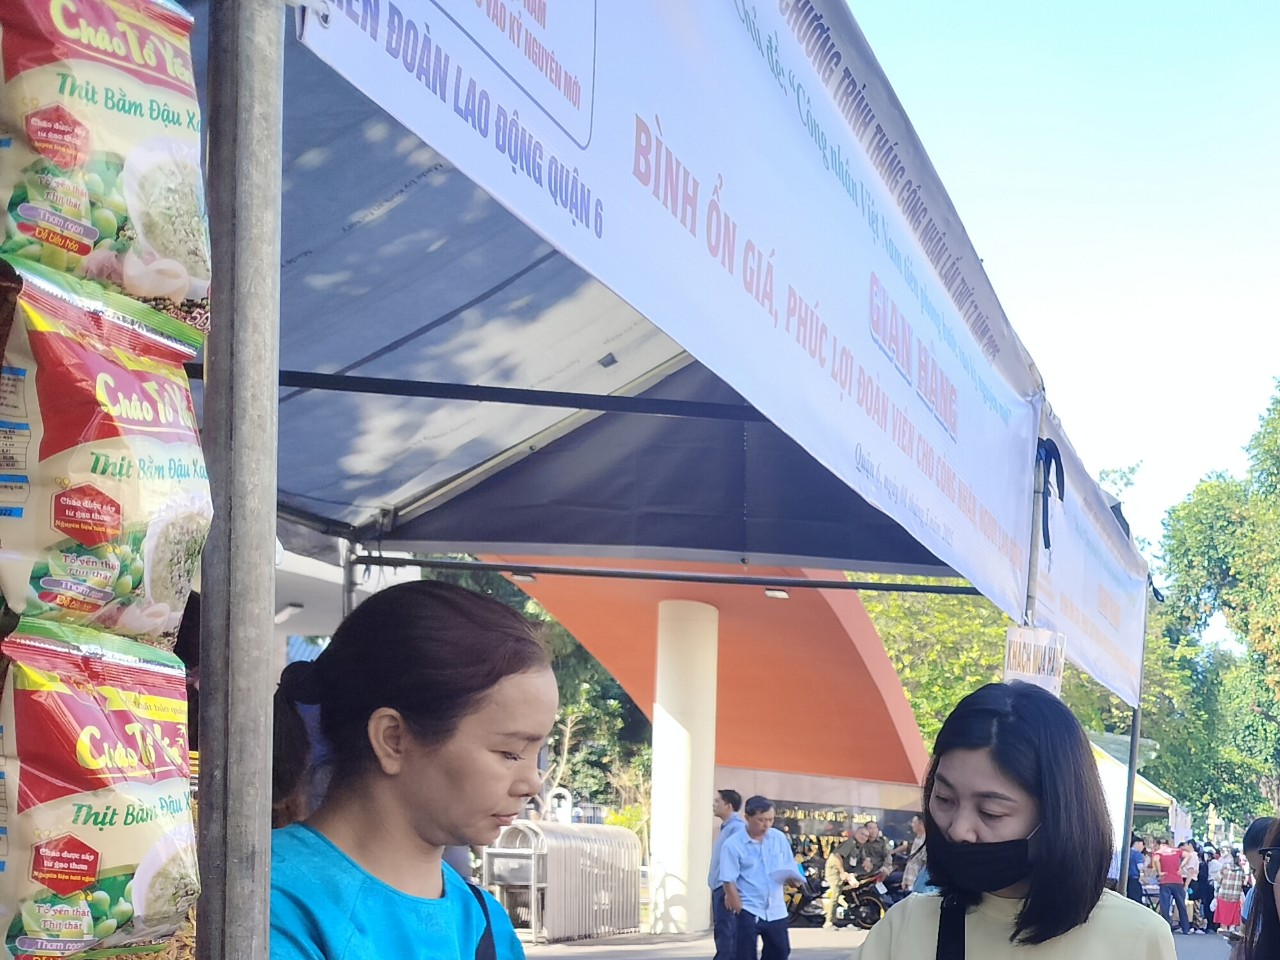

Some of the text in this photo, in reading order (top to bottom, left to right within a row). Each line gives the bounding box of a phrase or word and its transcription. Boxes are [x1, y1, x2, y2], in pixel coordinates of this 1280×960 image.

[56, 73, 98, 107] Thịt
[104, 88, 144, 118] Bằm
[149, 99, 182, 128] Đậu
[385, 1, 604, 239] ĐOÀN LAO ĐỘNG QUẬN 6
[833, 66, 875, 143] TRÌNH
[866, 124, 905, 195] THÁNG
[897, 180, 928, 234] CÔNG
[919, 218, 948, 270] NHÂN
[830, 144, 858, 208] nhân
[860, 180, 879, 245] Việt
[39, 209, 84, 235] Thơm ngon
[632, 113, 699, 238] BÌNH
[706, 173, 737, 275] ỔN
[743, 239, 778, 328] GIÁ,
[785, 284, 828, 368] PHÚC
[831, 335, 854, 402] LỢI
[856, 365, 889, 433] ĐOÀN
[892, 402, 915, 460] VIÊN
[916, 433, 934, 480] CHO
[869, 270, 958, 435] GIAN HÀNG
[96, 372, 153, 421] Cháo
[90, 452, 133, 482] Thịt
[138, 455, 165, 480] Bằm
[168, 458, 190, 483] Đậu
[60, 580, 89, 595] Thơm
[71, 803, 119, 831] Thịt
[124, 799, 158, 826] Bằm
[159, 794, 183, 820] Đậu
[36, 939, 64, 950] Thơm
